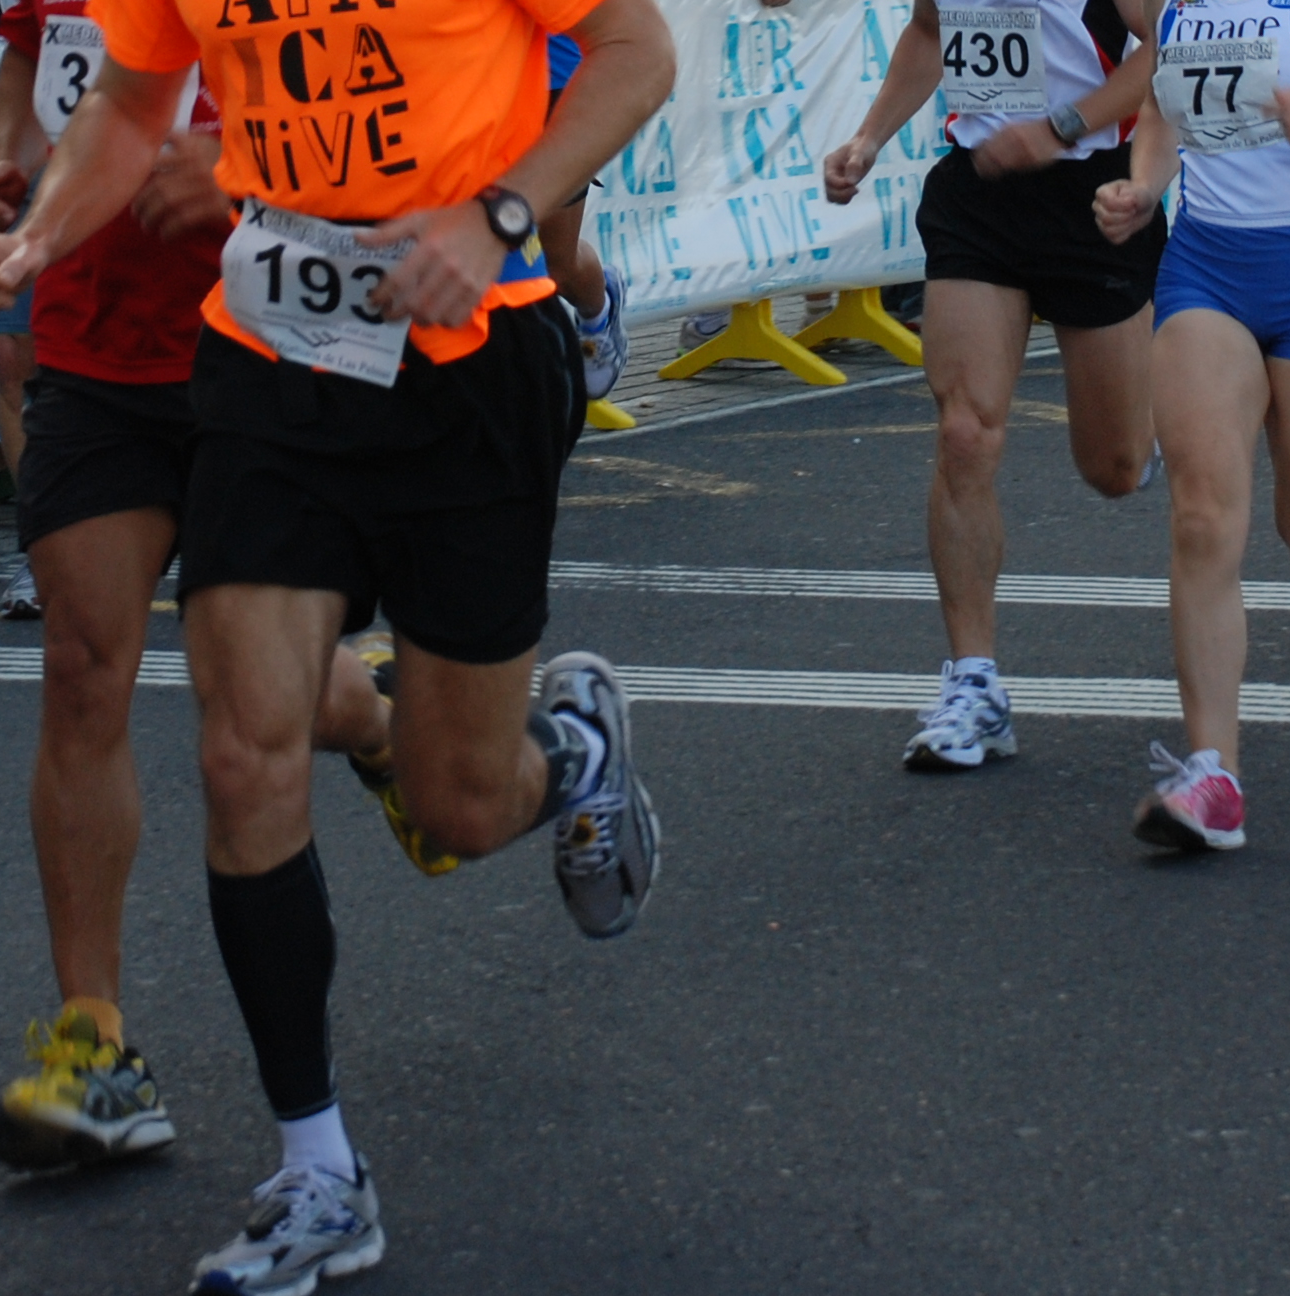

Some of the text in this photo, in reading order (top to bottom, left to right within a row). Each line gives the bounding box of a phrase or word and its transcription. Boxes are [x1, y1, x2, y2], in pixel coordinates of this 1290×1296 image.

[230, 23, 405, 107] ICA
[943, 30, 1030, 79] 430
[1183, 66, 1244, 116] 77
[720, 103, 814, 185] ICA
[254, 242, 386, 326] 193
